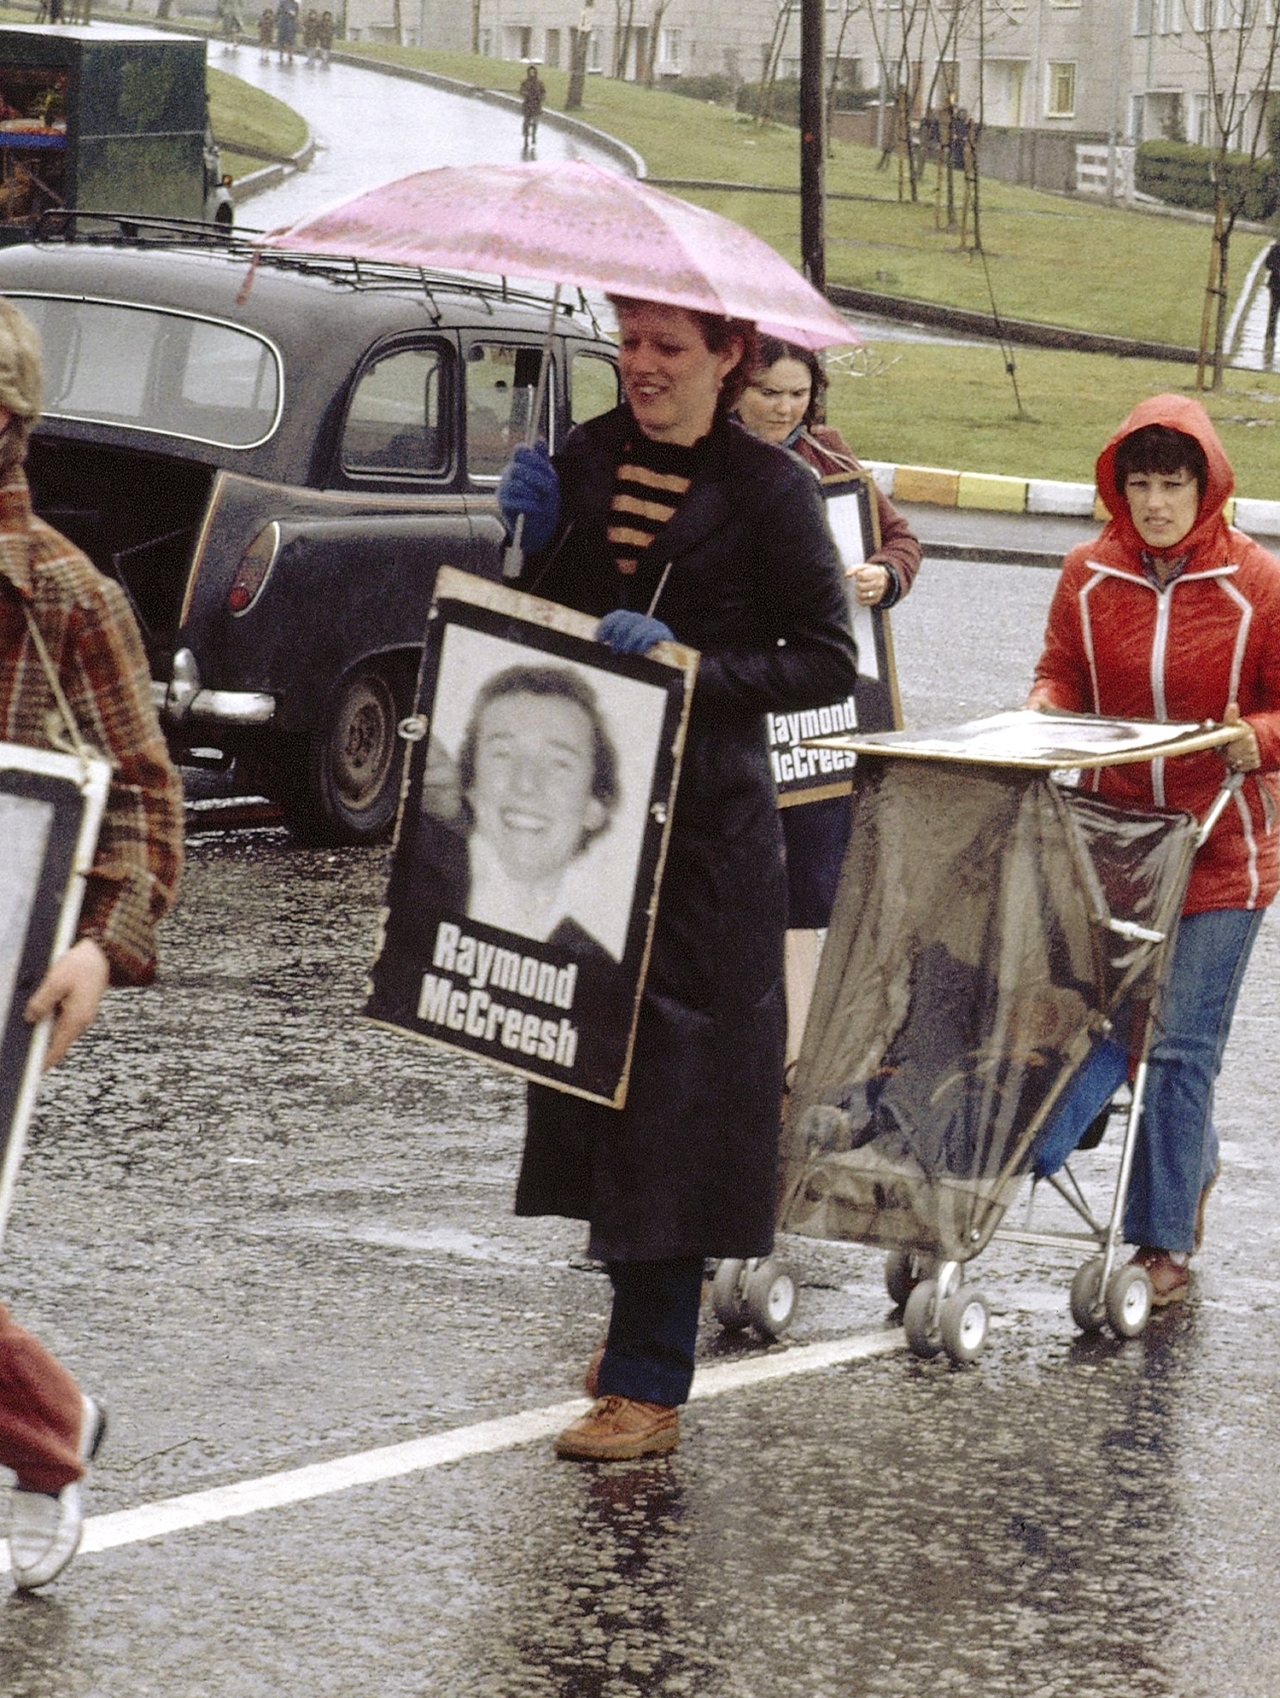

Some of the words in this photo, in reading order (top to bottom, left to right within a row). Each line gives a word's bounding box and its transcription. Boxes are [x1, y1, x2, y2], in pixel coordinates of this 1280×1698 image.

[770, 747, 858, 783] cCrees
[432, 921, 578, 1010] Raymond
[417, 973, 578, 1068] McCreesh
